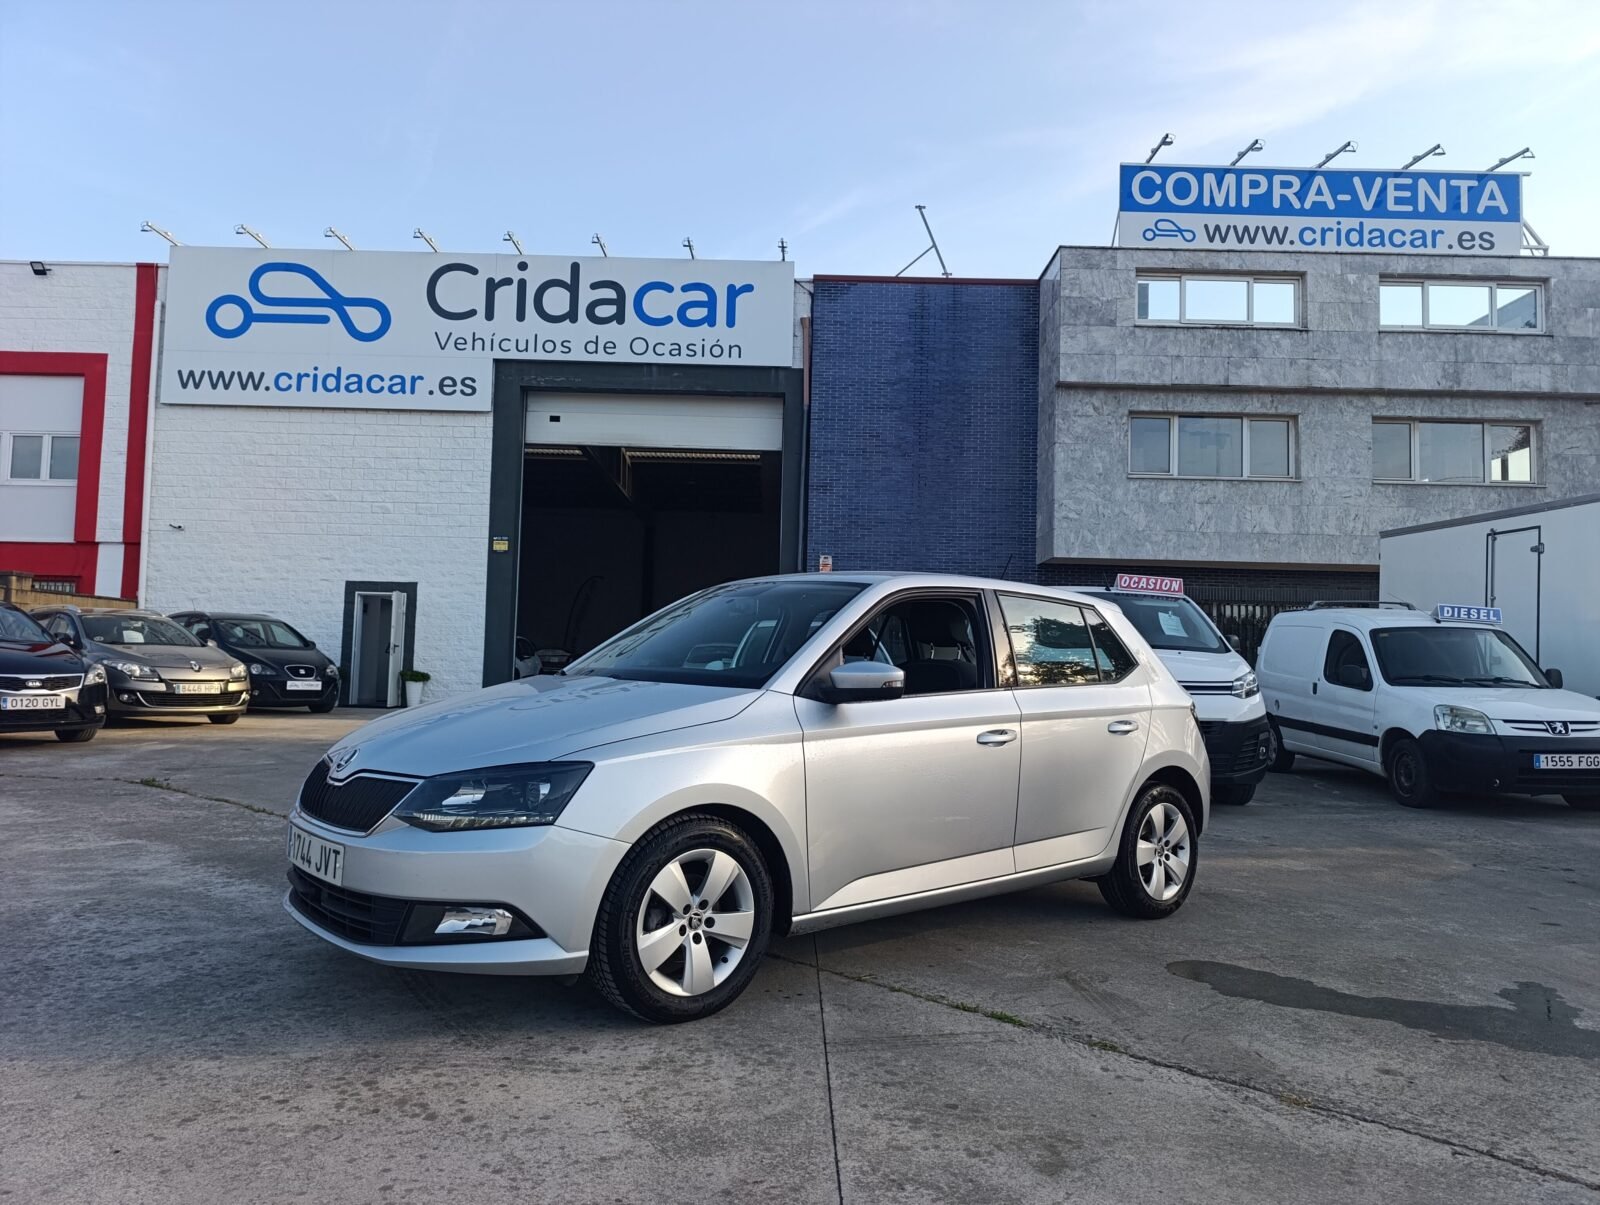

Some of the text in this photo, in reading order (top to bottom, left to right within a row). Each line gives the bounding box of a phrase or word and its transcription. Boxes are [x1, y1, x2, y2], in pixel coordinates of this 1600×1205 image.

[1131, 170, 1509, 215] COMPRA-VENTA
[1203, 221, 1496, 251] www.cridacar.es
[426, 261, 754, 328] Cridacar
[435, 332, 743, 359] Vehículos de Ocasión
[177, 366, 477, 396] www.cridacar.es
[1121, 576, 1180, 591] OCASION
[1443, 606, 1497, 620] DIESEL
[10, 698, 61, 708] 0120 GYL
[1545, 755, 1600, 767] 1555 FGG
[293, 831, 341, 880] 1744 JVT
